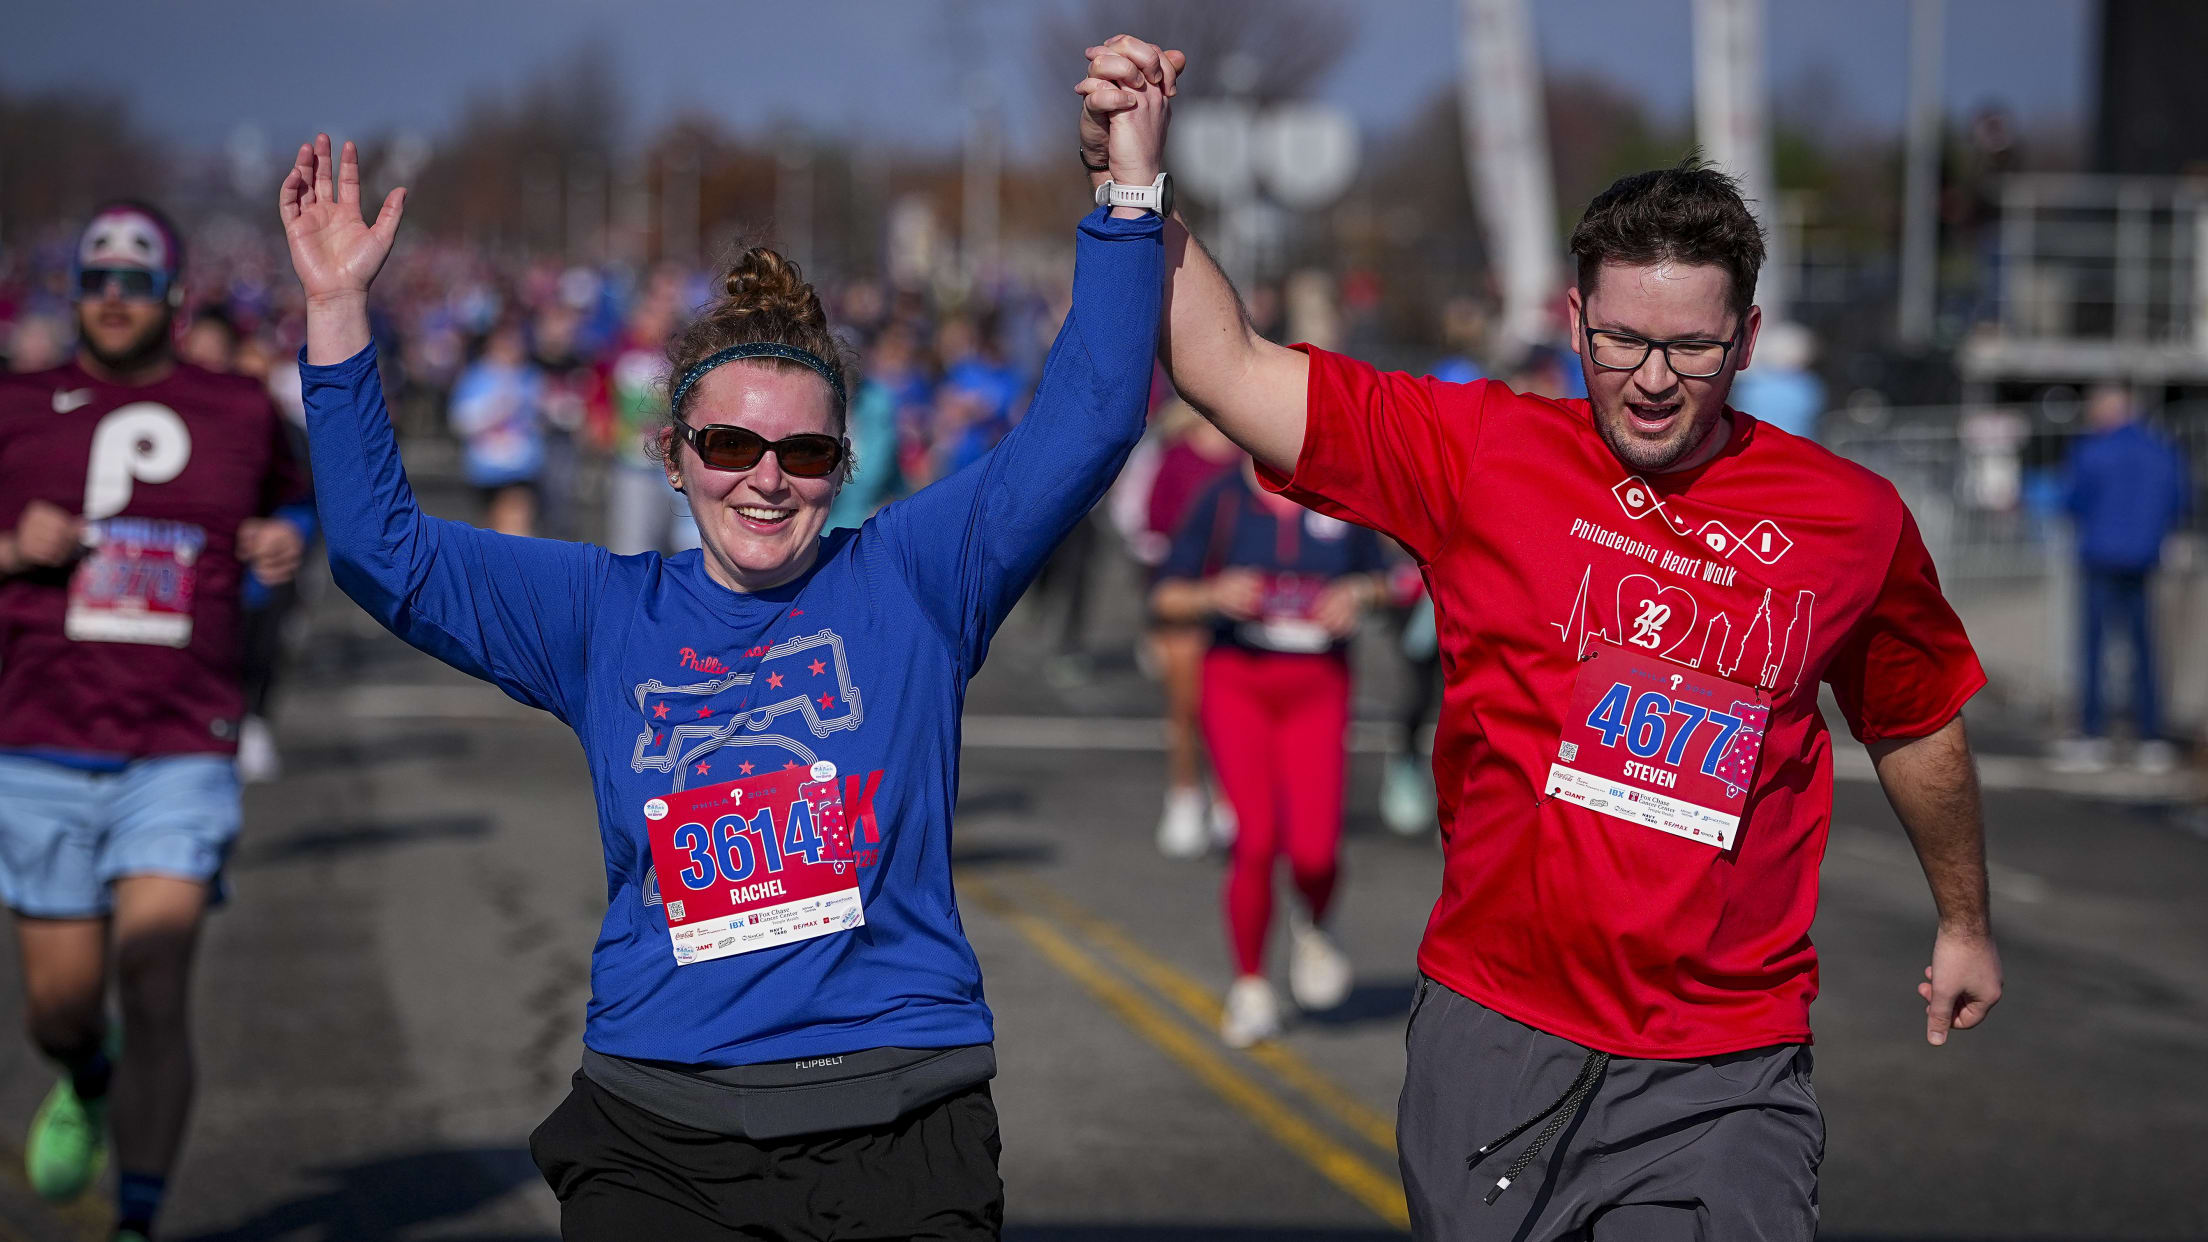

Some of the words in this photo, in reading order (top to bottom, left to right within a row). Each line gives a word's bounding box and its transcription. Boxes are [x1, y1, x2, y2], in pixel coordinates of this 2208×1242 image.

[1570, 517, 1659, 564] Philadelphia
[1659, 550, 1702, 578] Heart
[1702, 560, 1738, 587] Walk
[679, 647, 730, 674] Phillie
[1586, 682, 1744, 776] 4677
[1623, 760, 1678, 789] STEVEN
[1564, 790, 1586, 801] GIANT
[1608, 787, 1625, 799] IBX
[1640, 793, 1651, 802] Fox
[1651, 797, 1670, 807] Chase
[692, 797, 729, 811] PHILA
[844, 769, 885, 845] K
[1638, 799, 1658, 808] Cancer
[1657, 803, 1676, 813] Center
[1663, 820, 1688, 831] RE/MAX
[674, 799, 825, 890] 3614
[853, 848, 880, 869] 026
[729, 879, 787, 905] RACHEL
[759, 911, 771, 919] Fox
[772, 906, 790, 917] Chase
[759, 913, 780, 923] Cancer
[779, 910, 798, 920] Center
[729, 919, 745, 930] IBX
[793, 920, 818, 931] RE/MAX
[696, 943, 713, 952] IANT
[795, 1055, 844, 1070] FLIPBELT
